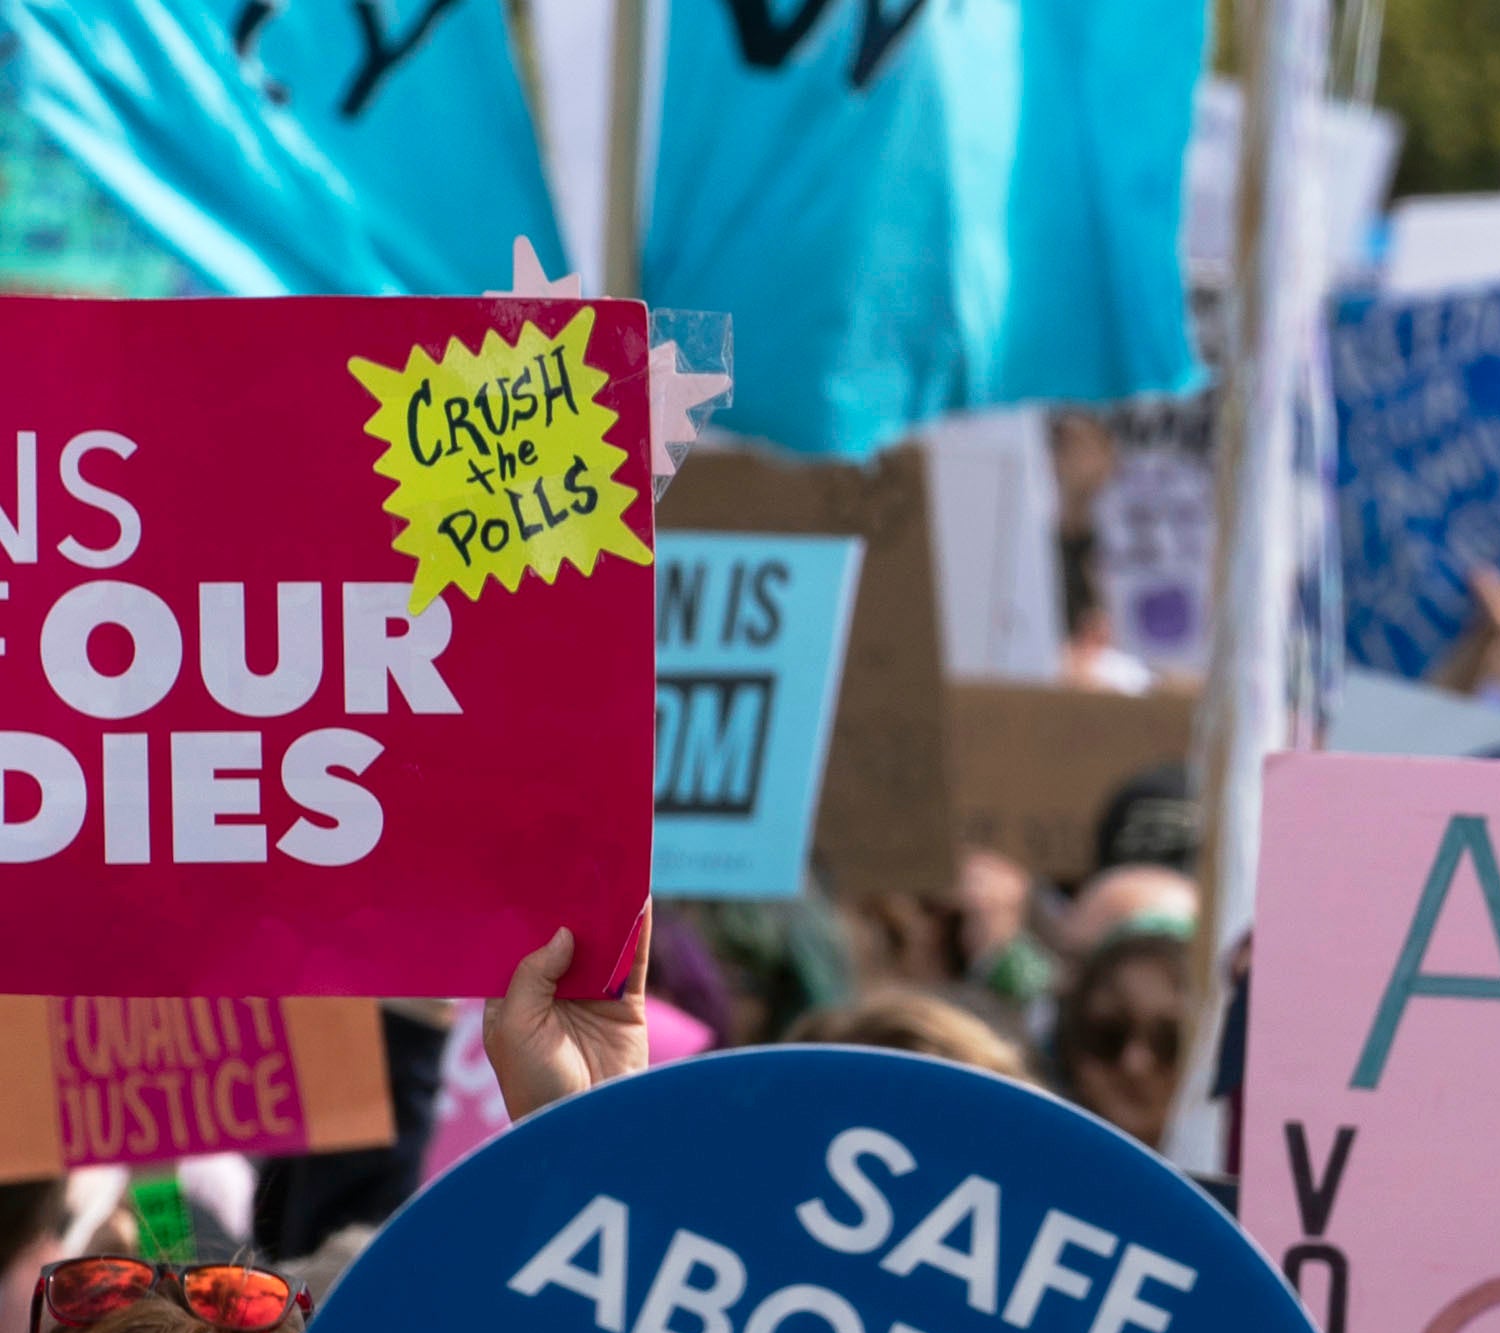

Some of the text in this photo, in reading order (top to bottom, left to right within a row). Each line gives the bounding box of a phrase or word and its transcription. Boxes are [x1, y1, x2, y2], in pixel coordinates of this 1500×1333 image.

[406, 345, 580, 468] CRUSH
[467, 441, 540, 496] the
[40, 580, 464, 719] OUR
[720, 558, 791, 648] IS
[61, 1052, 296, 1162] JUSTICE
